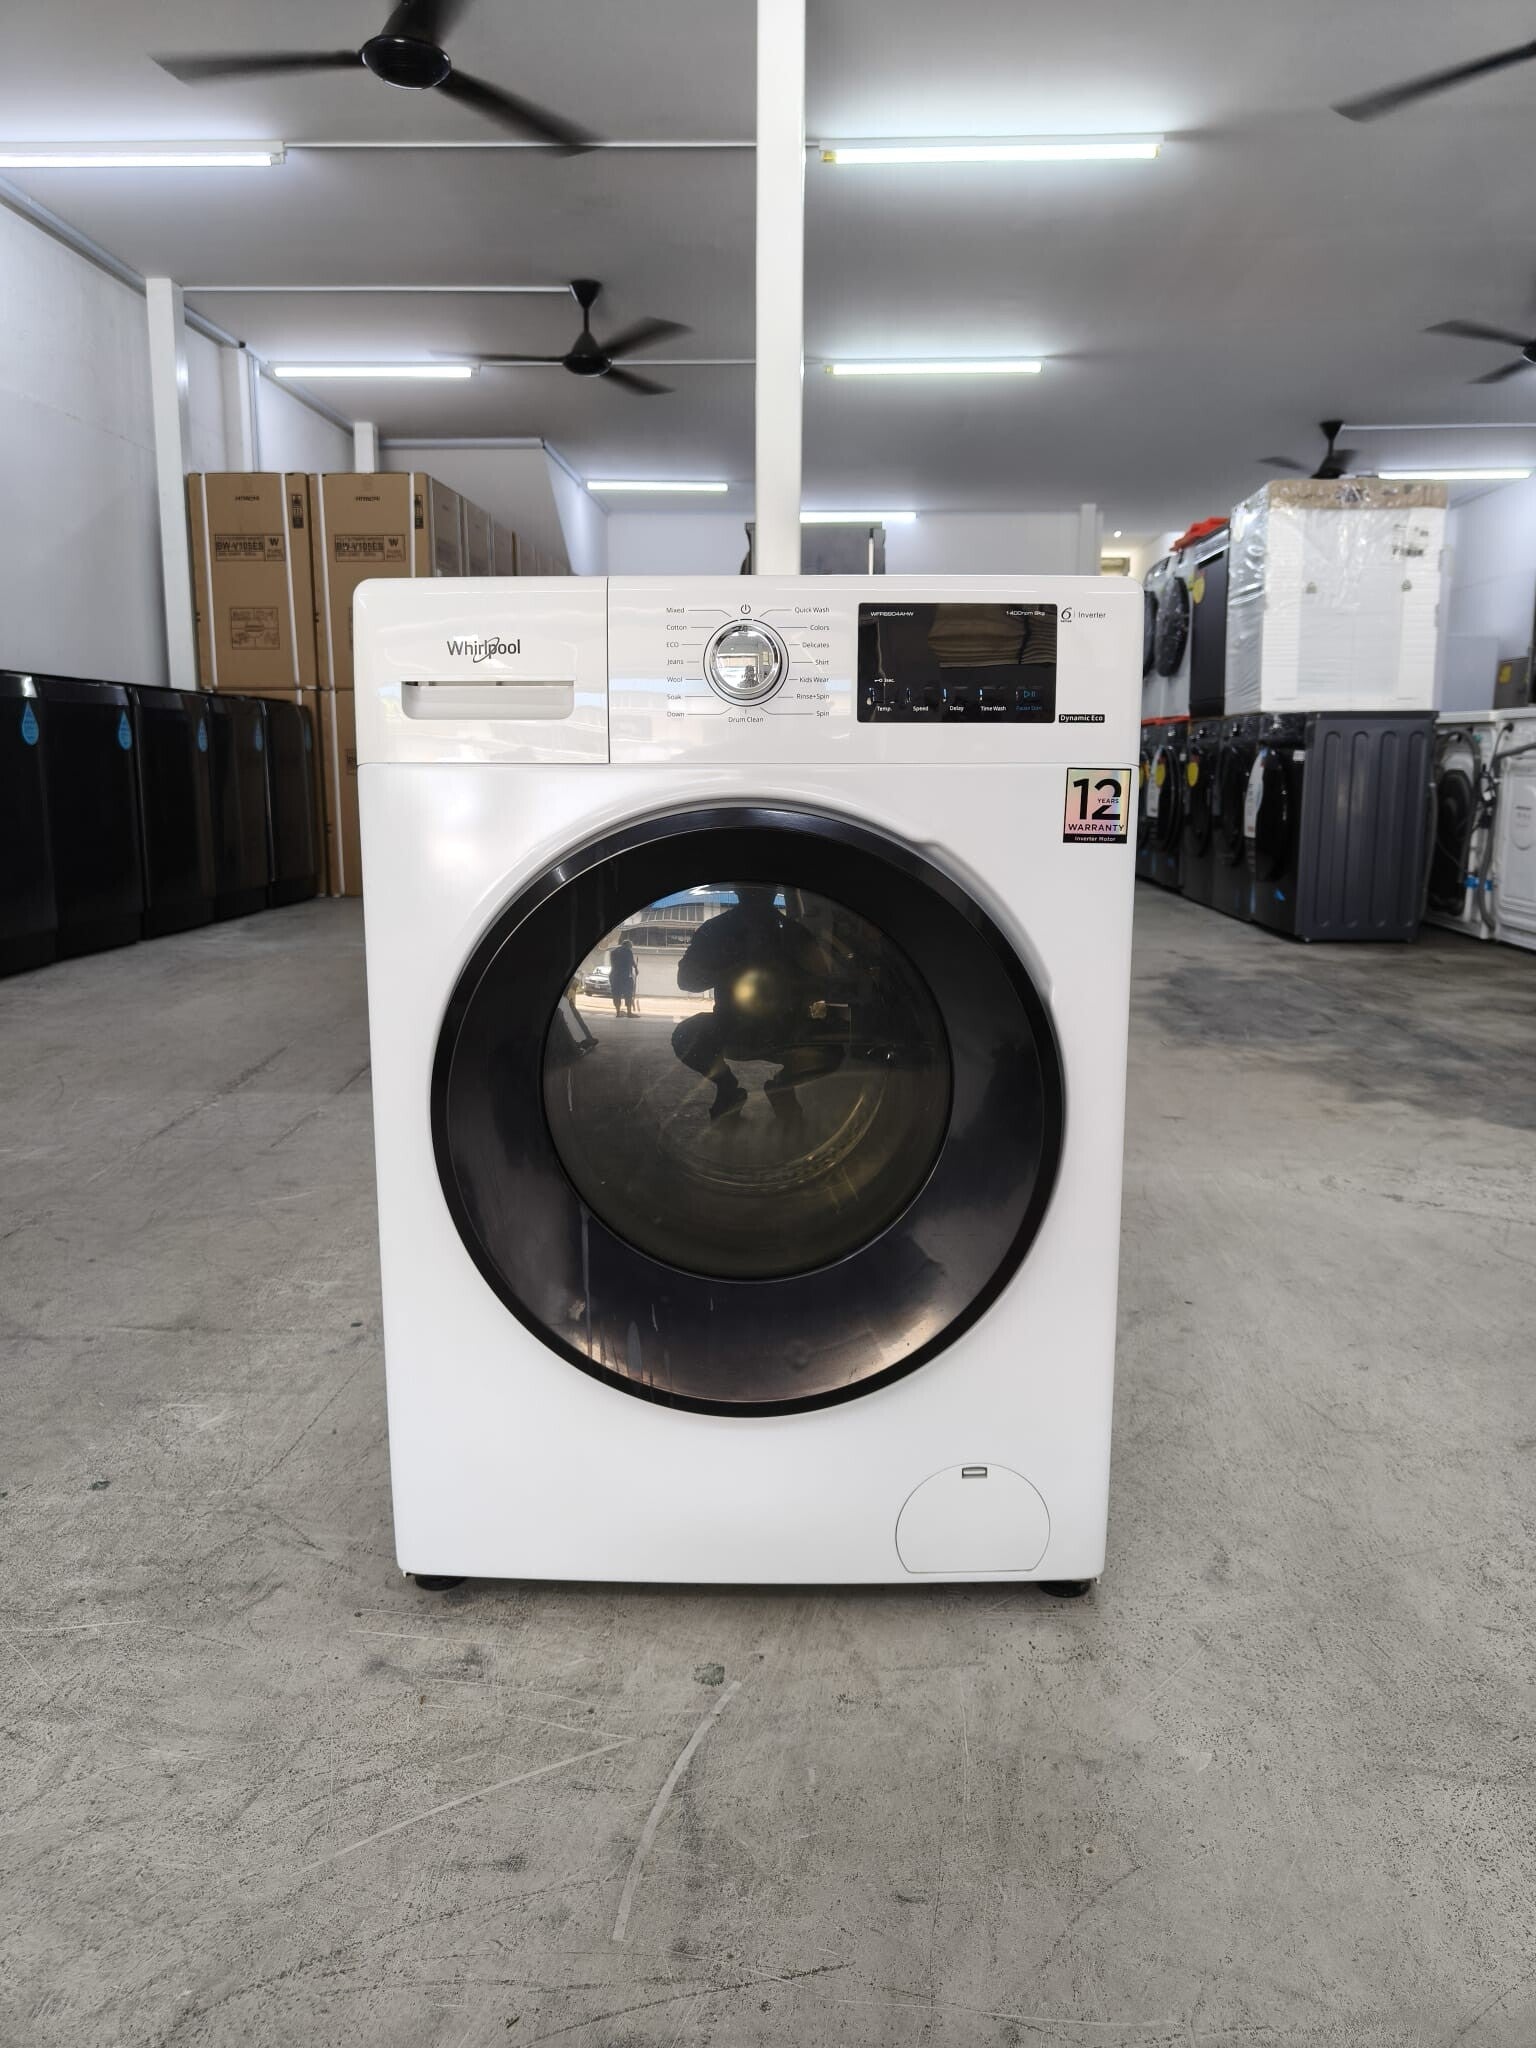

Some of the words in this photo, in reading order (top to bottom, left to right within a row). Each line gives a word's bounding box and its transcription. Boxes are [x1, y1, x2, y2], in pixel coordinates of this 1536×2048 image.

[794, 607, 811, 615] Quick
[1078, 611, 1106, 619] Inverter
[446, 638, 521, 661] Whirlpool
[796, 693, 830, 701] Rinse+Spin
[816, 711, 830, 719] Spin
[1060, 714, 1090, 723] Dynamic
[1091, 714, 1104, 722] Eco
[1073, 778, 1122, 820] 12
[1068, 823, 1125, 832] WARRANTY
